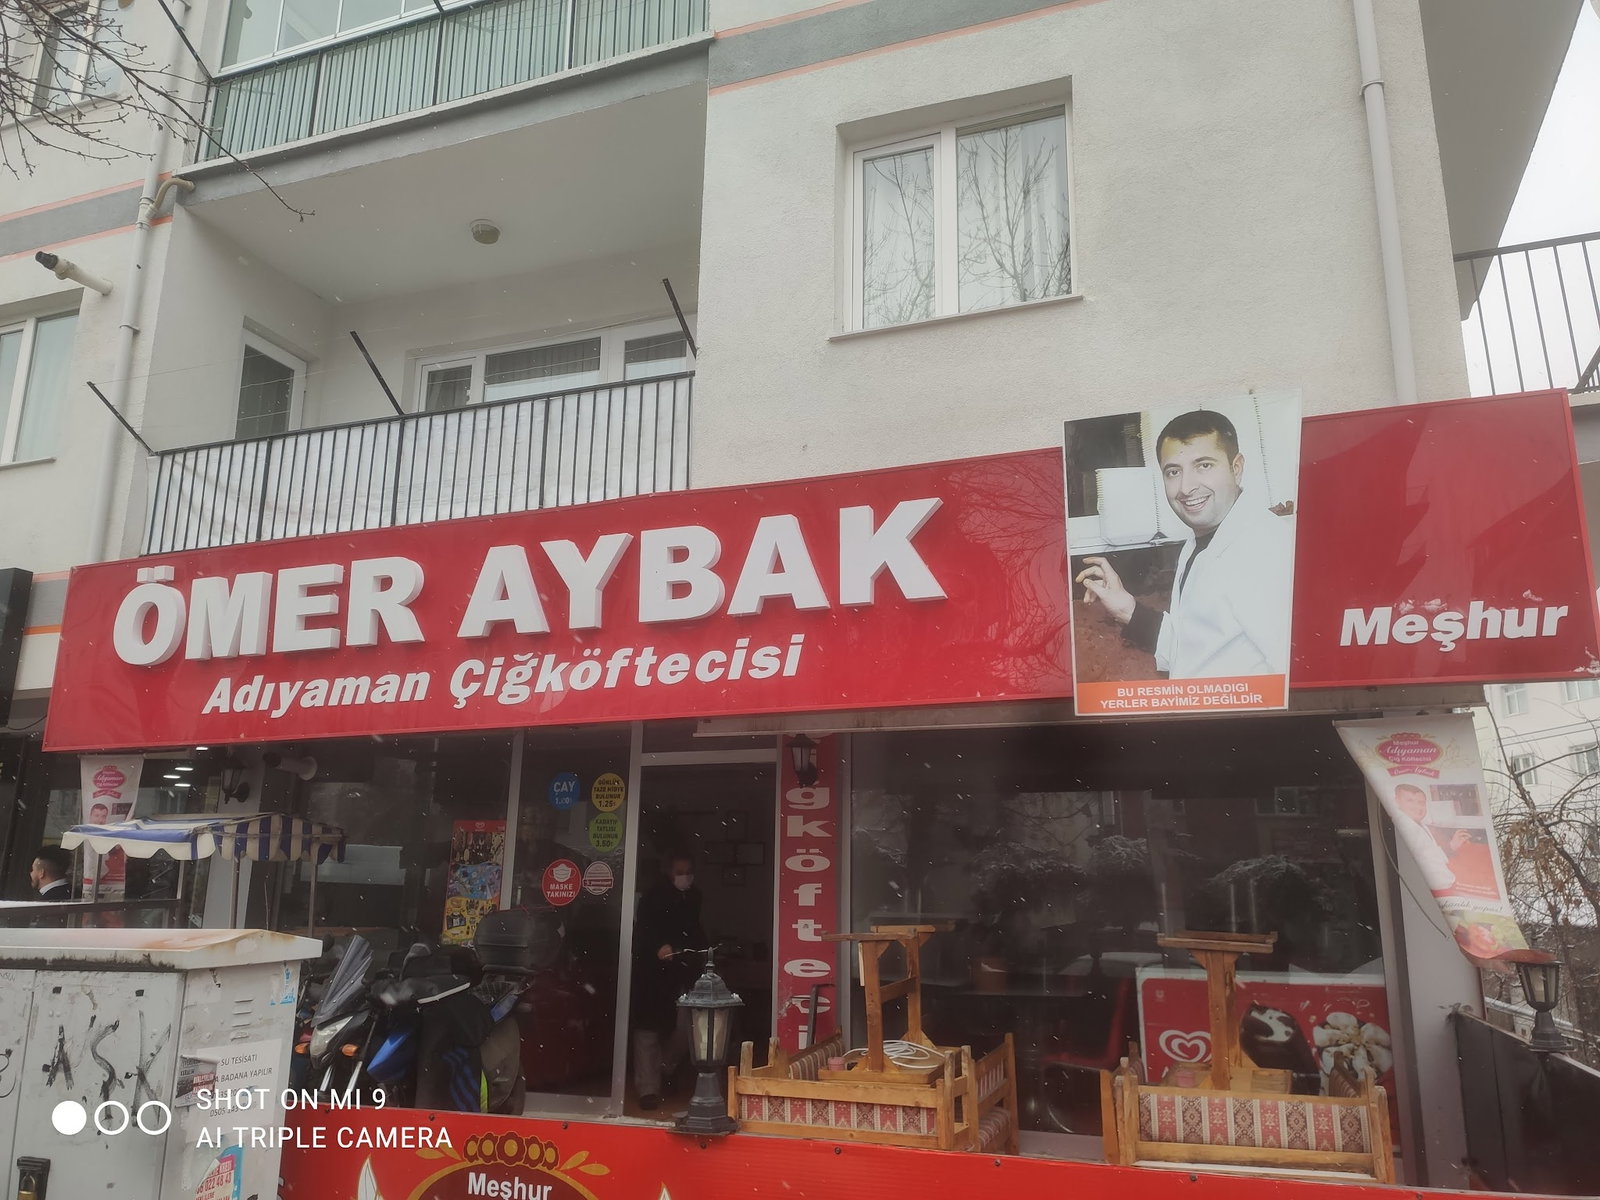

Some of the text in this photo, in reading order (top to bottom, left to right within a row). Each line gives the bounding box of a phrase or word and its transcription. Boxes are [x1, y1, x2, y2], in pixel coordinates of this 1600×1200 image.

[112, 496, 949, 667] ÖMER AYBAK
[1340, 600, 1569, 653] Meşhur
[201, 633, 806, 719] Adıyaman Çiğköftecisi
[1100, 694, 1263, 709] YERLER BAYİMİZ DEĞİLDİR
[1117, 687, 1134, 697] BU
[1137, 685, 1184, 697] RESMİN
[220, 1058, 230, 1067] SU
[220, 1071, 248, 1083] BADANA
[249, 1067, 273, 1078] YAPILIR
[467, 1171, 553, 1200] Meşhur
